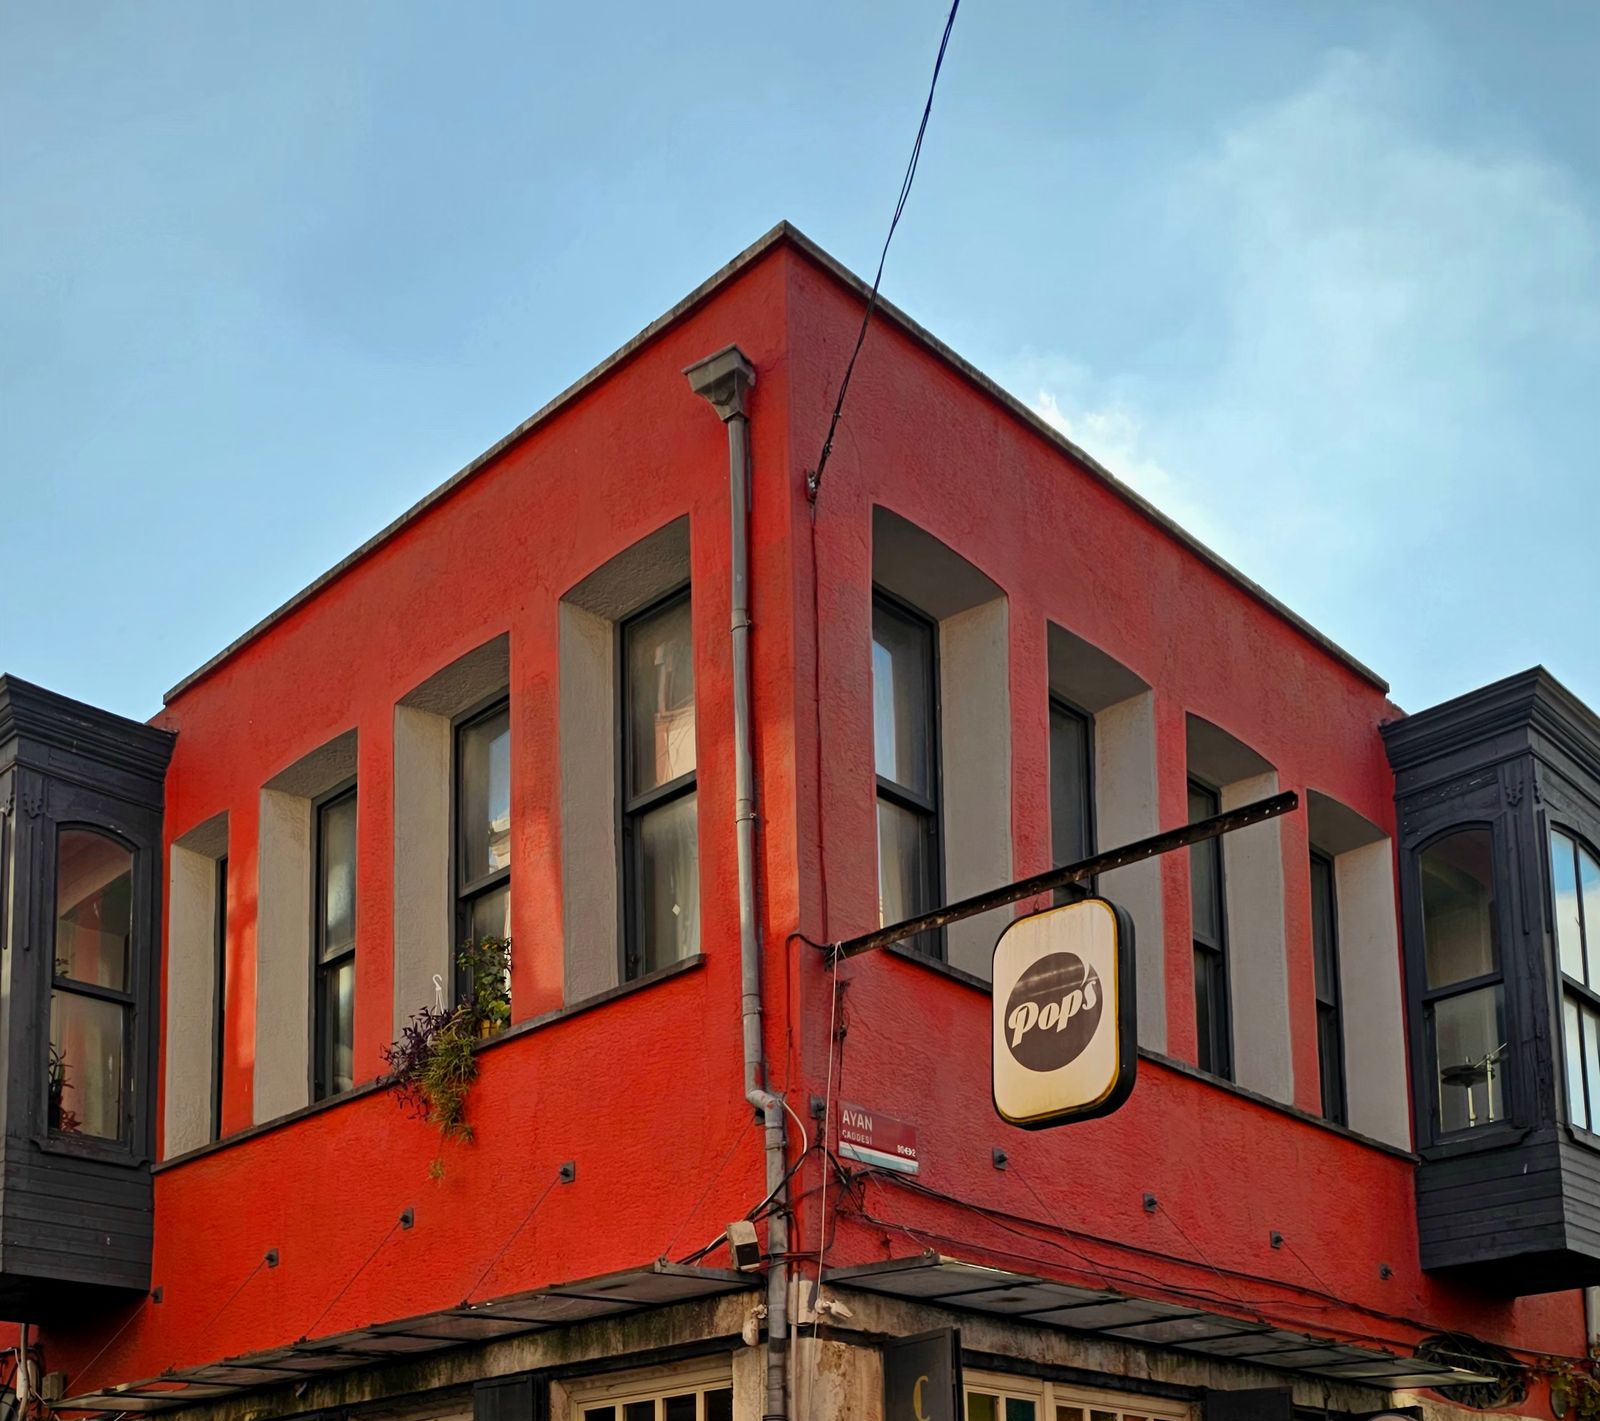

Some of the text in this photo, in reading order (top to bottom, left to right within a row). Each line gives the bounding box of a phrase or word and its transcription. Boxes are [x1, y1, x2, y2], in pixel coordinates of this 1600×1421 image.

[1008, 978, 1098, 1049] Pops
[842, 1109, 873, 1132] AYAN
[841, 1129, 873, 1145] CADDESİ
